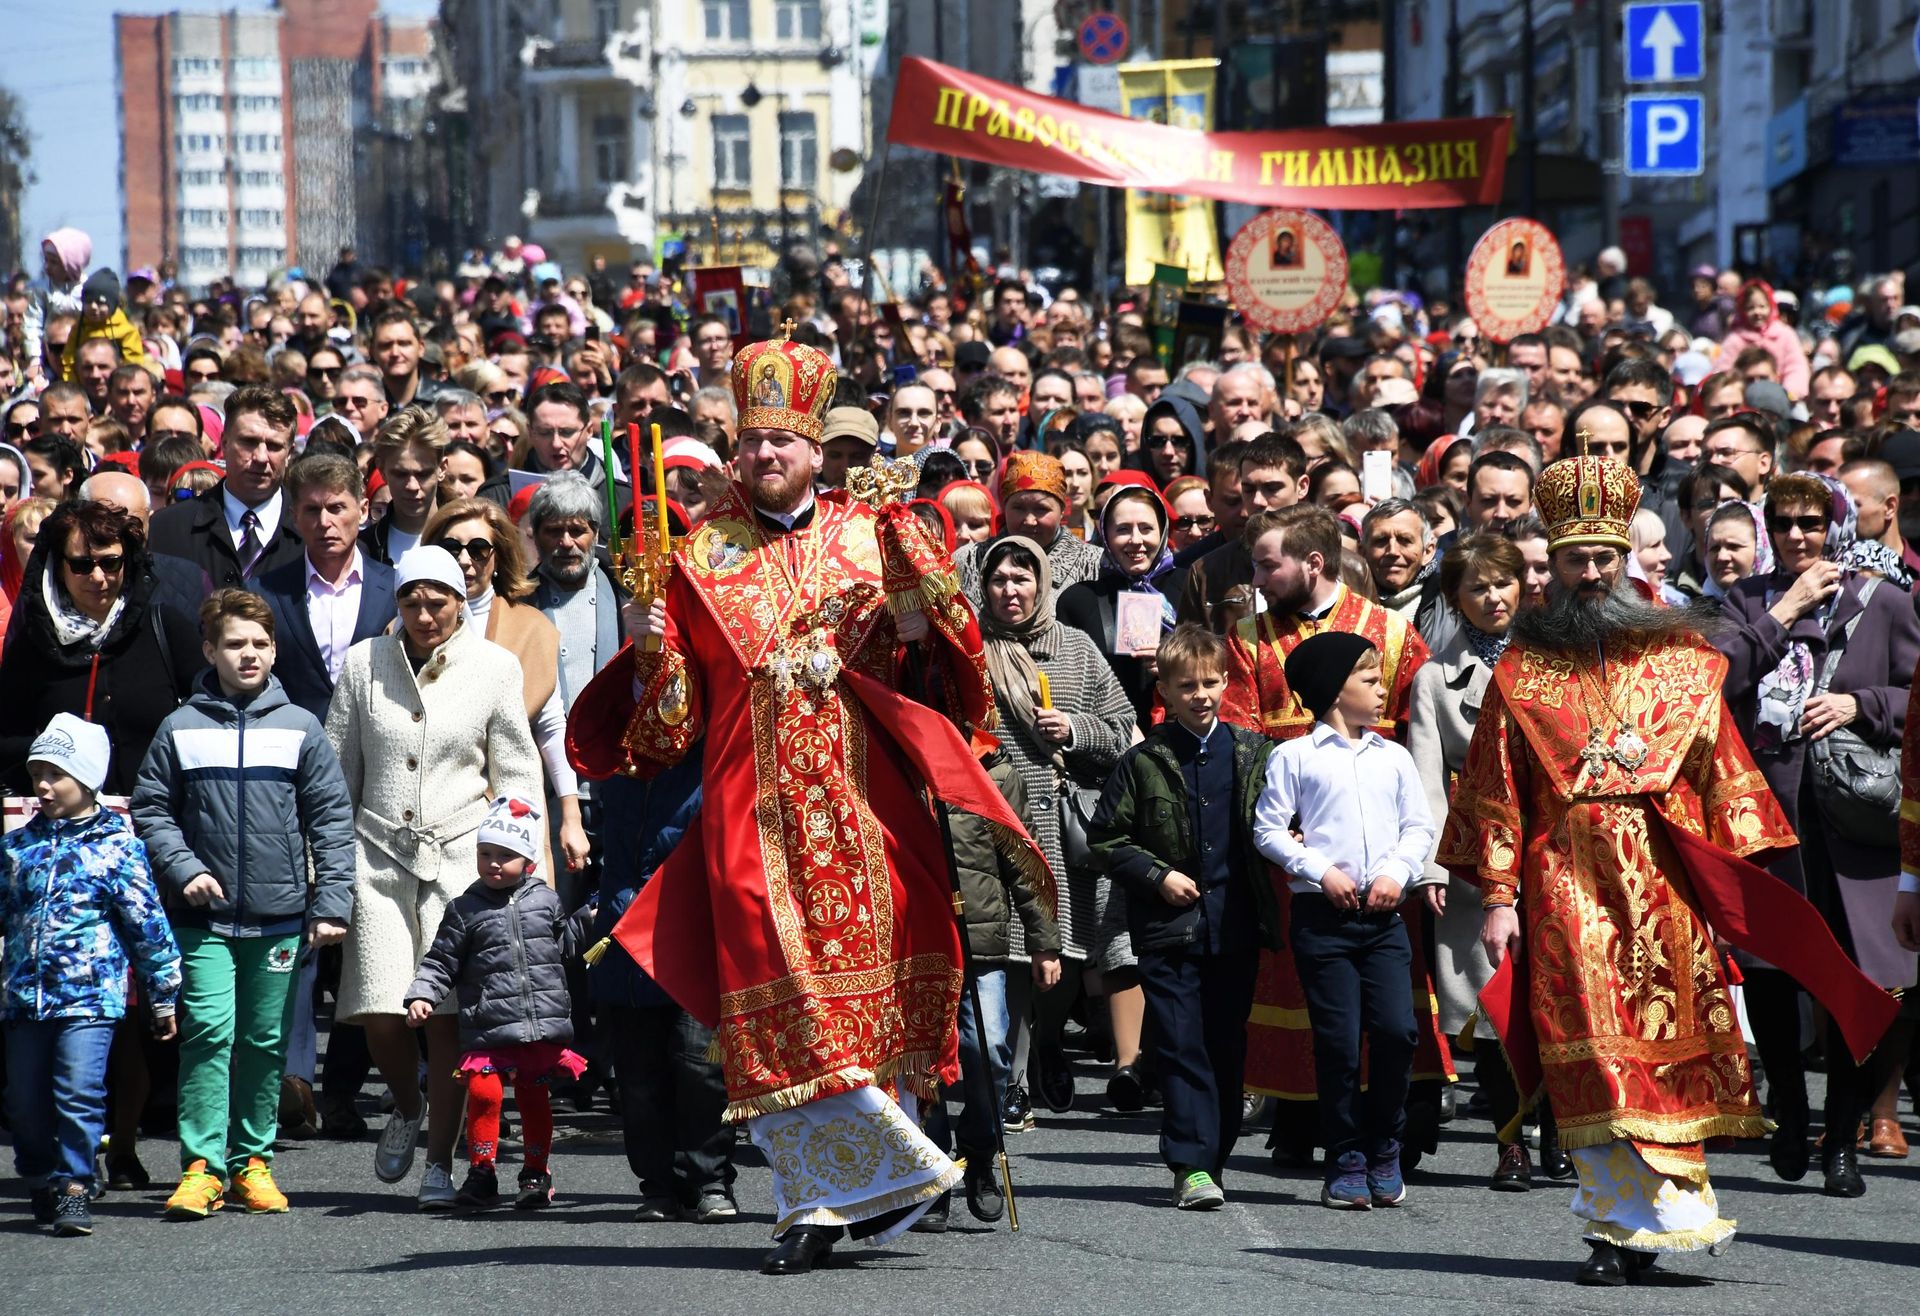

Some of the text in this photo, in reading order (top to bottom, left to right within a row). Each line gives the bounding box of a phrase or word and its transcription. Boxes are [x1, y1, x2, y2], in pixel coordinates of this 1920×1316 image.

[933, 87, 1480, 188] ПРАВОСЛААЯ ГИМНАЗИЯ
[1646, 105, 1690, 168] P
[479, 819, 531, 842] PAPA
